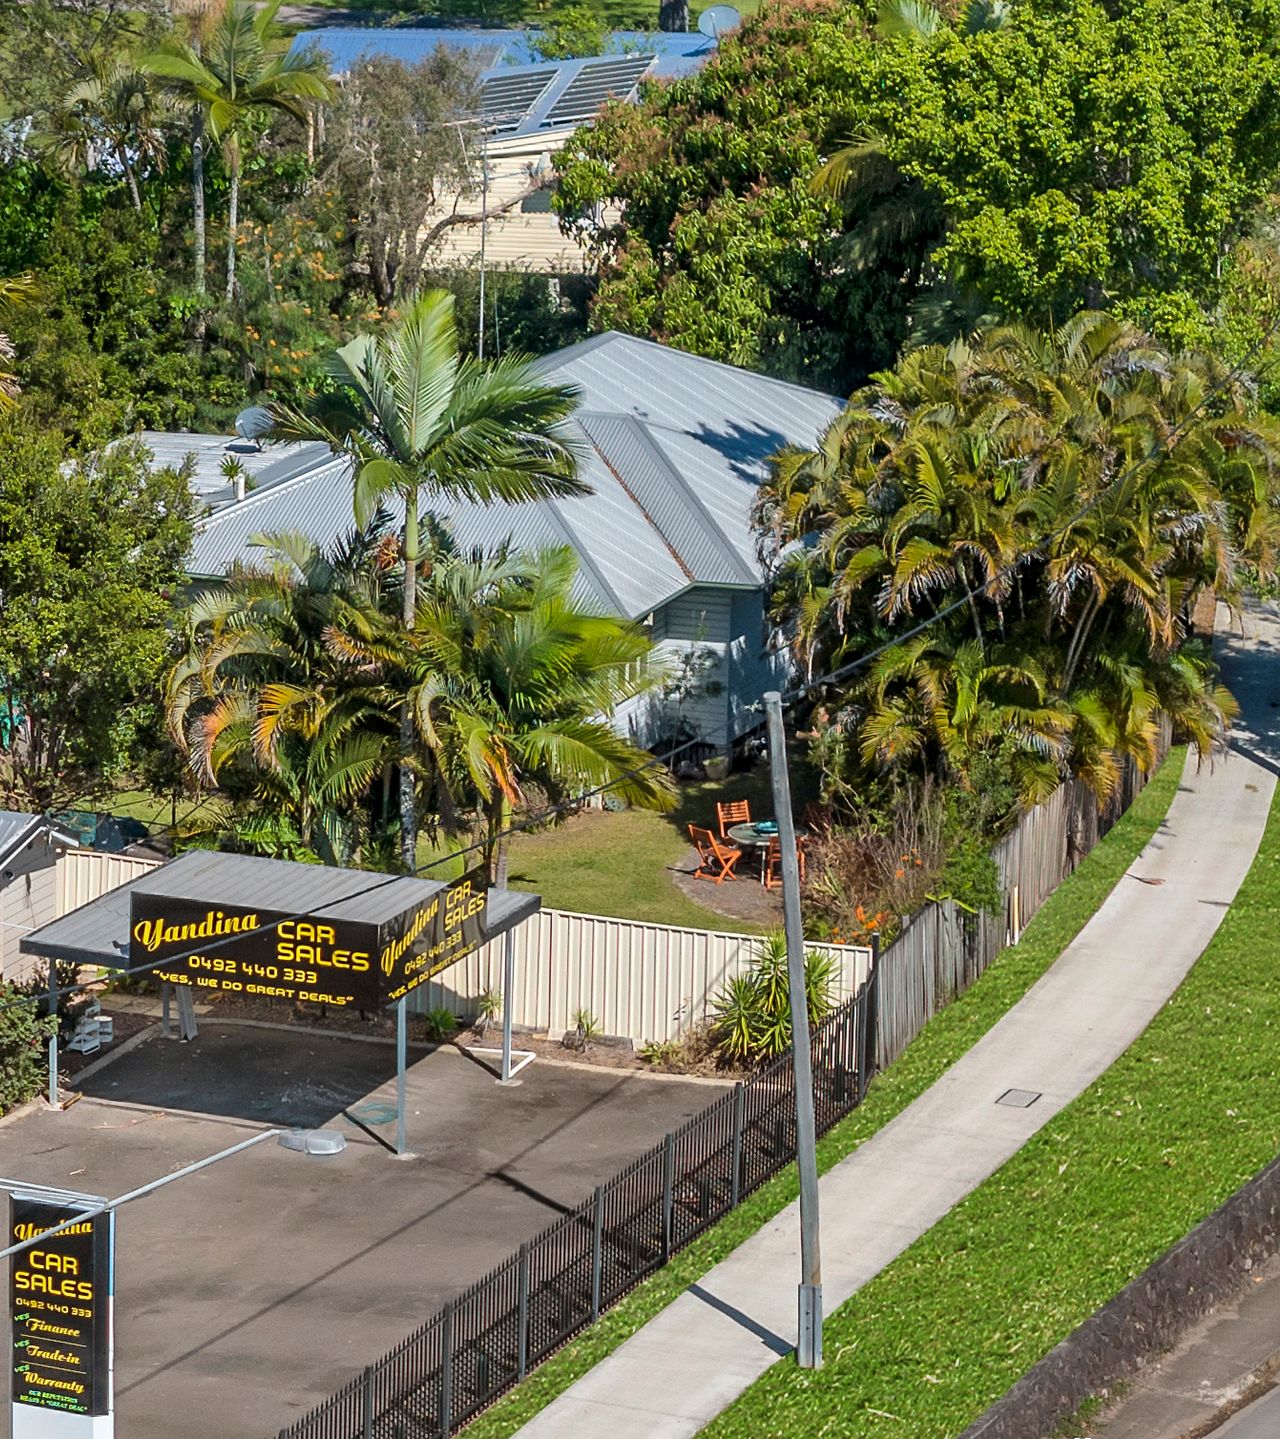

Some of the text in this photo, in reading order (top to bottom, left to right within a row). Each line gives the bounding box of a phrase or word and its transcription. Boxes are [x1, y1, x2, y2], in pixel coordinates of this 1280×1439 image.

[446, 880, 471, 910] CAR
[444, 892, 485, 932] SALES
[134, 911, 261, 952] Yandina
[277, 921, 335, 945] CAR
[381, 898, 439, 977] Yandina
[277, 942, 370, 971] SALES
[404, 930, 462, 975] 0492 440 333
[189, 955, 318, 984] 0492 440 333
[408, 977, 418, 990] WE
[419, 971, 429, 982] DO
[429, 957, 452, 975] GREAT
[197, 977, 218, 989] WE
[222, 980, 242, 991] DO
[246, 984, 294, 998] GREAT
[299, 991, 354, 1006] DEALS"
[29, 1250, 79, 1275] CAR
[15, 1271, 93, 1301] SALES
[15, 1297, 92, 1318] 0492 440 333
[25, 1318, 81, 1337] Finance
[26, 1345, 81, 1364] Trade-in
[23, 1371, 85, 1394] Warranty
